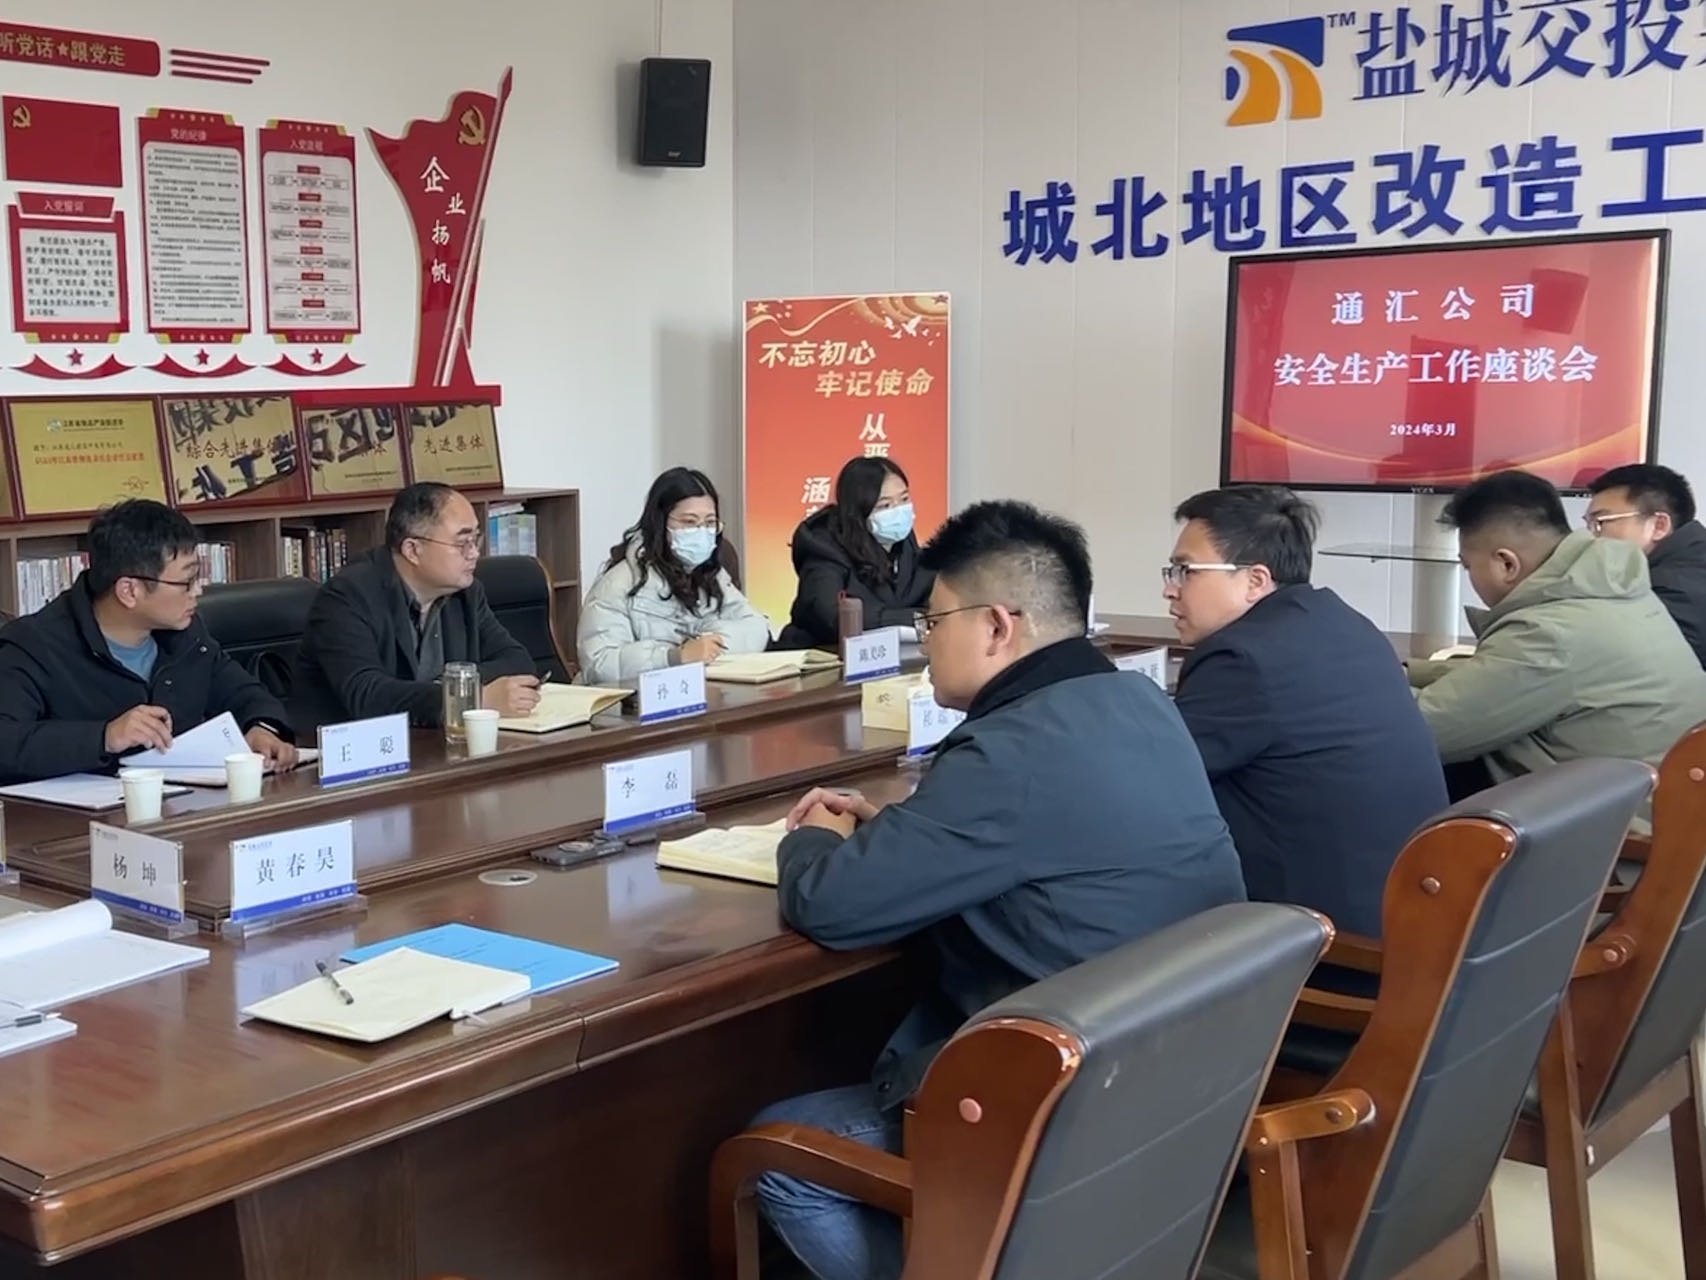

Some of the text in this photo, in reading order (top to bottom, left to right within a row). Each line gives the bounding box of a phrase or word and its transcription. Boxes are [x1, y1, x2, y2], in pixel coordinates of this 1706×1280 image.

[1326, 11, 1357, 29] TM
[0, 31, 126, 67] 听党话 跟党走
[1352, 0, 1706, 101] 盐城交投
[1002, 129, 1706, 267] 城北地区改造工
[419, 156, 467, 284] 企业扬帆
[1331, 283, 1536, 325] 通汇公司
[759, 340, 877, 368] 不忘初心
[1274, 345, 1599, 387] 安全生产工作座谈会
[815, 368, 935, 398] 牢记使命
[1390, 423, 1457, 438] 2024年3月
[622, 770, 679, 799] 李磊
[113, 852, 157, 887] 杨坤
